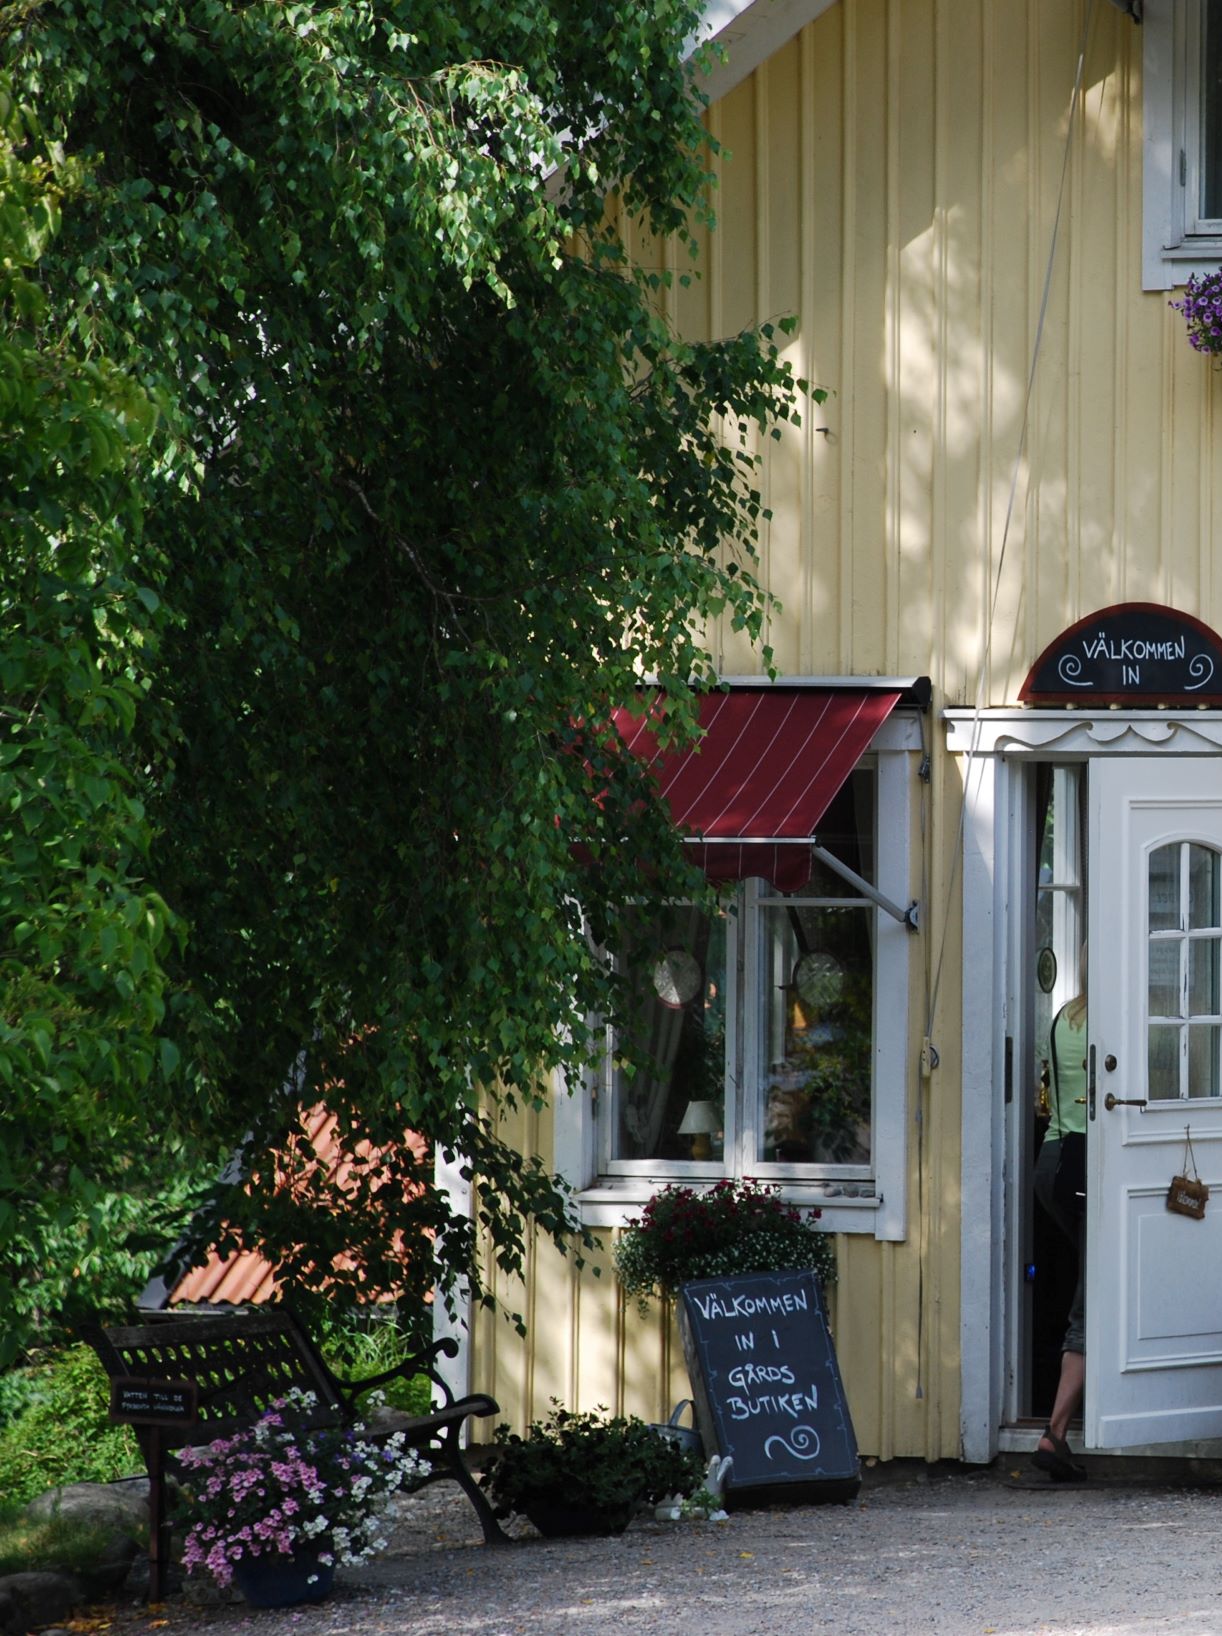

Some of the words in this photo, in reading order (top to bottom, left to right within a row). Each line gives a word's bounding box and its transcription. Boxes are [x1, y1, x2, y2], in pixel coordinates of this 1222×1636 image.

[1082, 632, 1186, 660] VÄLKOMMEN
[1122, 665, 1140, 685] IN
[693, 1289, 808, 1320] VÄLKOMMEN
[734, 1331, 754, 1351] IN
[728, 1363, 796, 1395] GÅRDS
[726, 1384, 818, 1420] BUTIKEN
